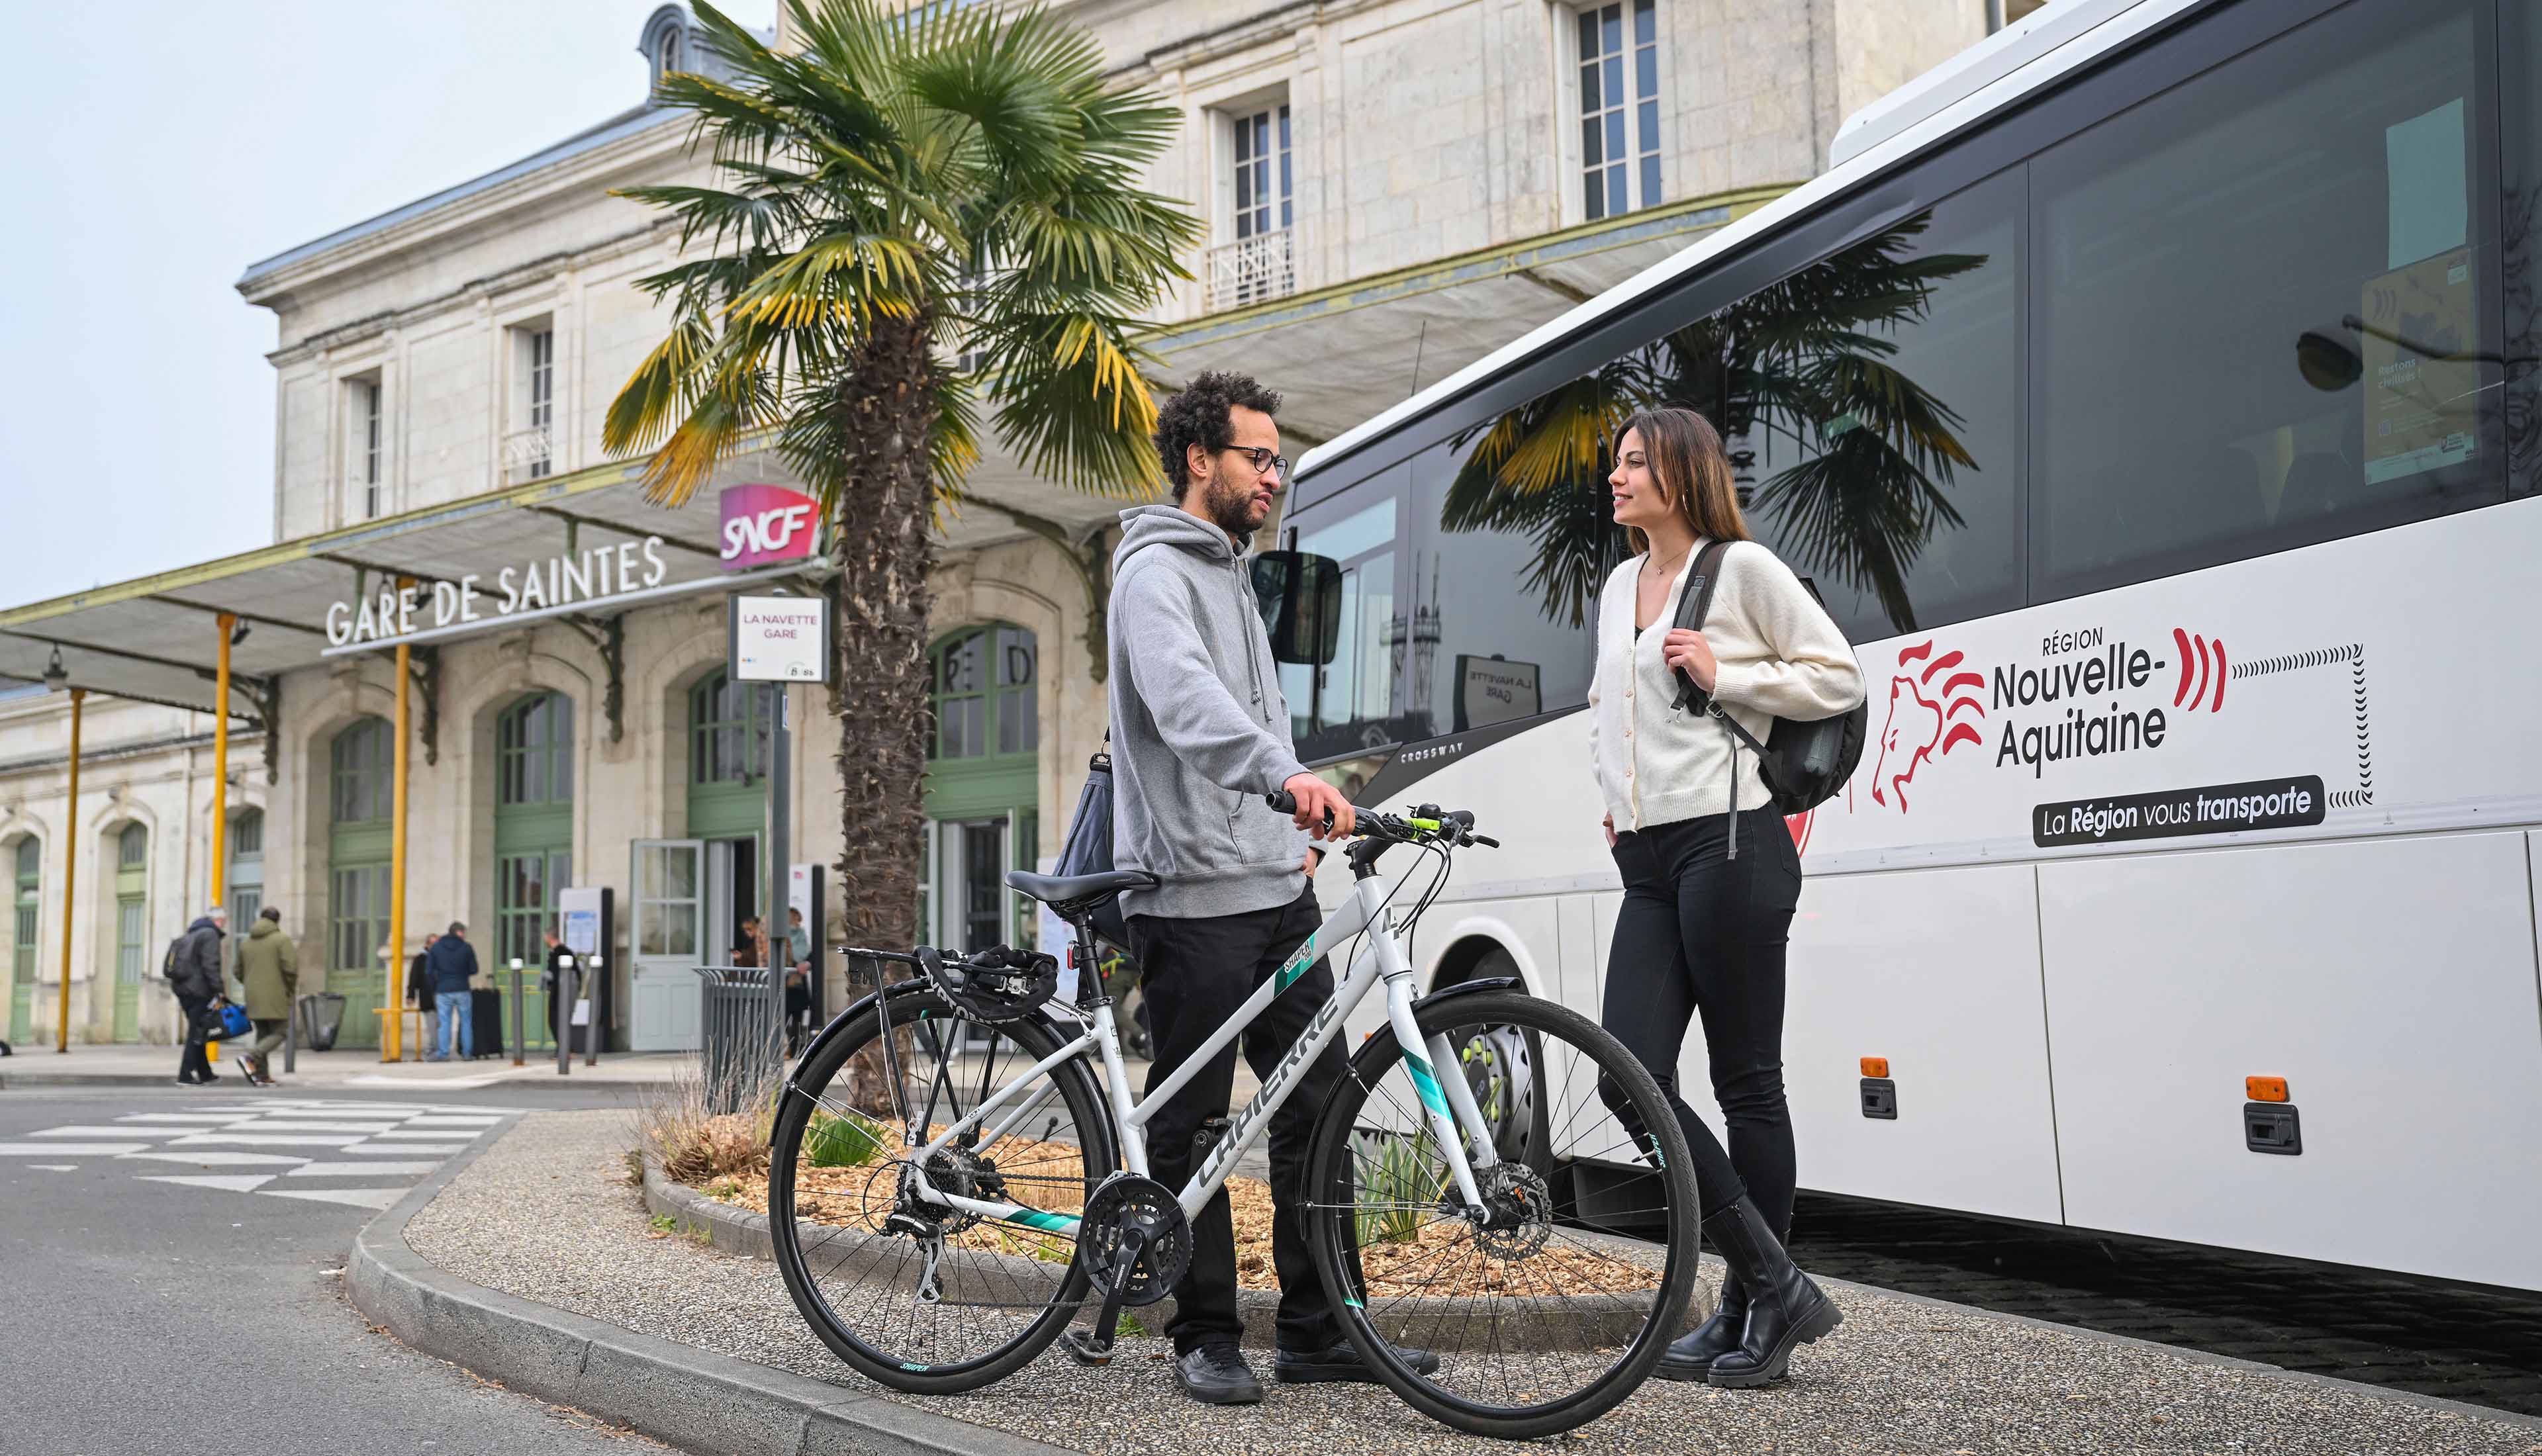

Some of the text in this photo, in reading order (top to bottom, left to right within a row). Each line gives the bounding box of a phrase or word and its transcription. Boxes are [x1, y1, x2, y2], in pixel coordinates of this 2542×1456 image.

[721, 504, 811, 559] SNCF
[326, 536, 666, 646] GARE DE SAINTES
[744, 614, 817, 625] LA NAVETTE
[764, 629, 797, 639] GARE
[2043, 627, 2102, 657] RÉGION
[1993, 641, 2165, 709] Nouvelle-
[1401, 742, 1463, 763] CROSSWAY
[1996, 701, 2166, 779] Aquitaine
[2044, 786, 2311, 837] La Région vous transporte
[1285, 940, 1310, 972] SHAPER
[1199, 996, 1339, 1188] LAPIERRE
[1648, 1132, 1666, 1168] SHAPER
[1114, 1263, 1126, 1289] SHIMANO
[900, 1362, 930, 1372] SHAPER
